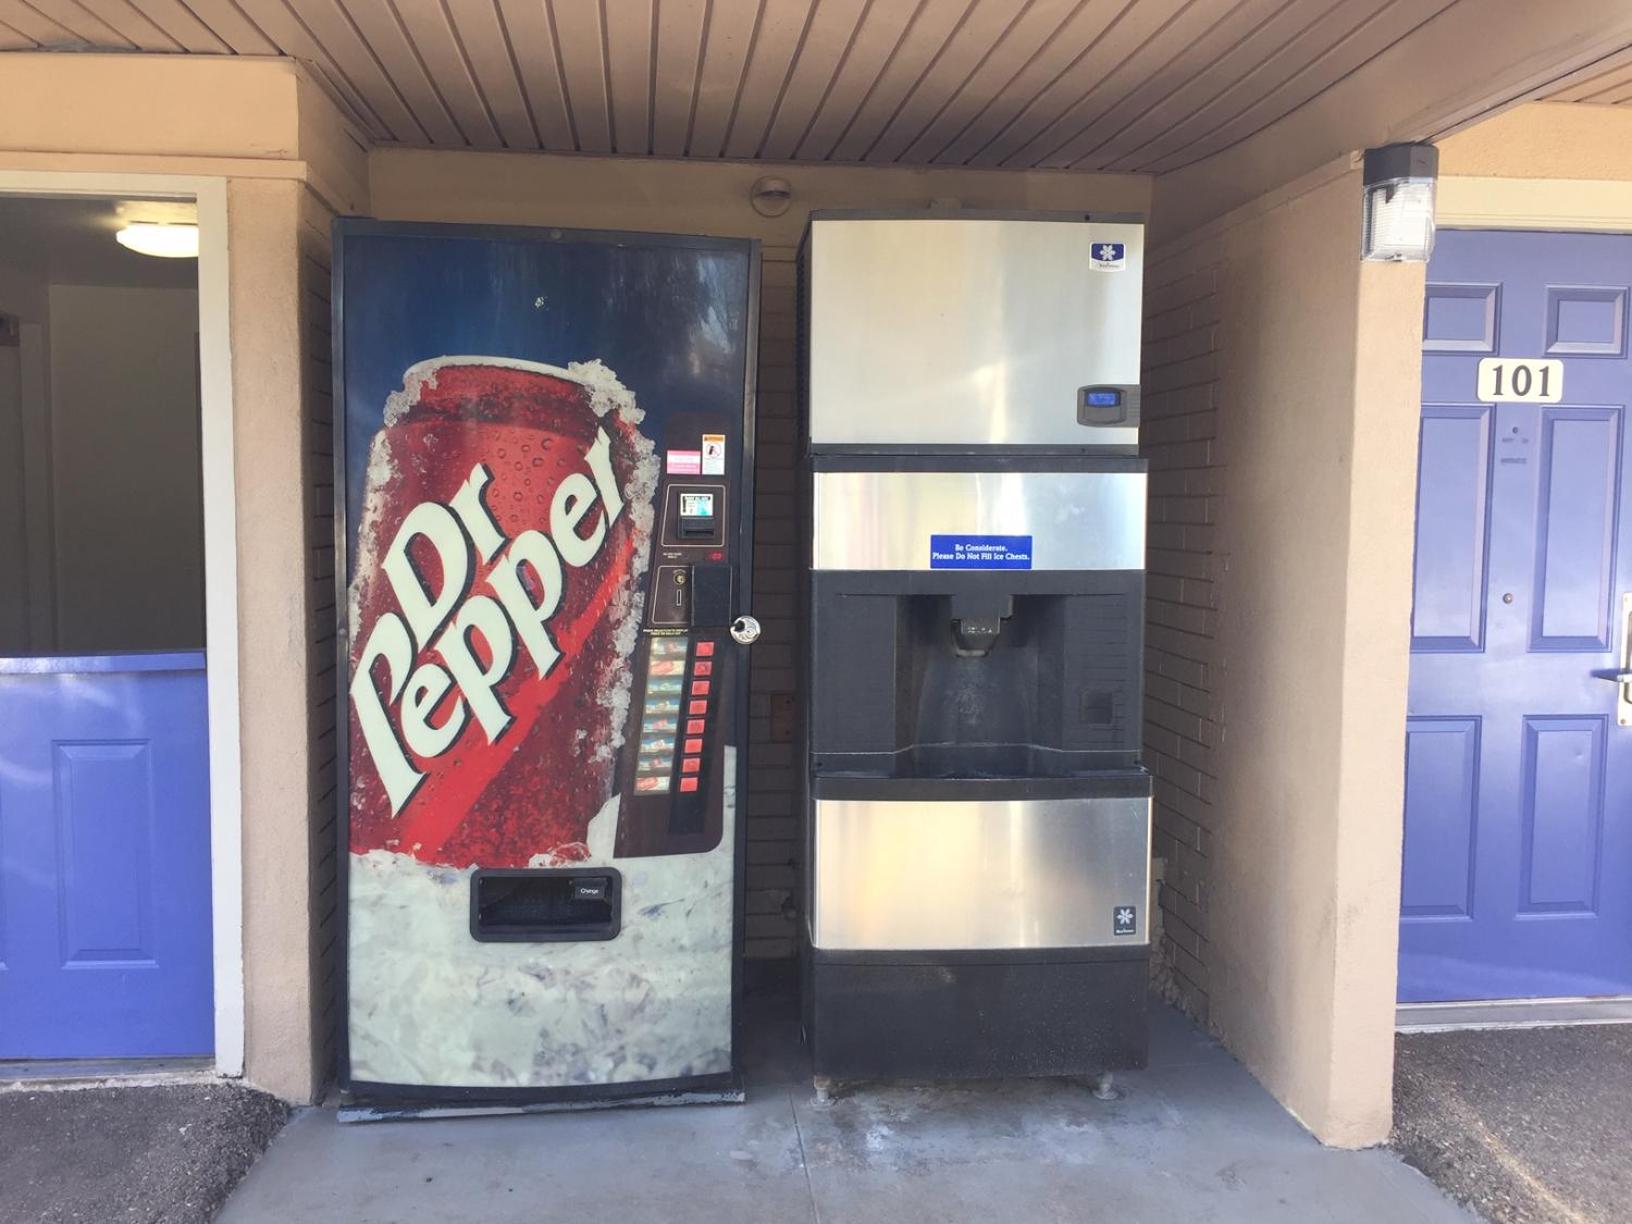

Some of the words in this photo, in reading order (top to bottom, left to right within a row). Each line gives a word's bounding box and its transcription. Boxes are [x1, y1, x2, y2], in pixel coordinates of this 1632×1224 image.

[1492, 364, 1550, 397] 101
[382, 463, 506, 649] Dr
[932, 552, 954, 560] Please
[955, 552, 966, 560] Do
[955, 544, 964, 552] Be
[965, 544, 1008, 552] Considerate.
[350, 426, 624, 818] Pepper
[580, 887, 599, 895] Change
